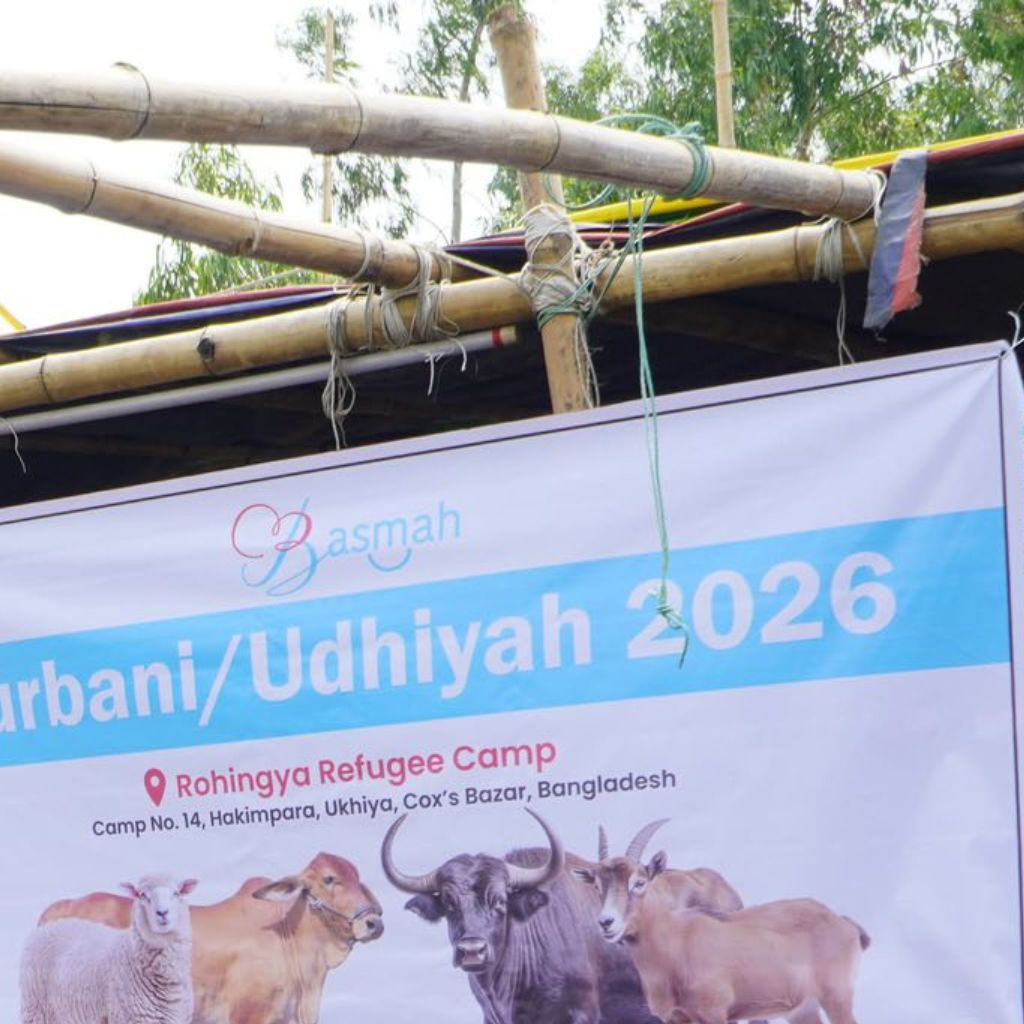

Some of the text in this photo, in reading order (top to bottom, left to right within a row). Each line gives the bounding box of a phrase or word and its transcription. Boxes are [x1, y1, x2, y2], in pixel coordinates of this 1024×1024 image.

[231, 497, 461, 596] Basmah
[627, 552, 896, 659] 2026
[92, 818, 146, 838] Camp
[151, 815, 179, 831] No.
[183, 812, 205, 830] 14,
[210, 805, 320, 827] Hakimpara,
[326, 795, 398, 819] Ukhiya,
[465, 785, 532, 805] Bazar,
[538, 769, 676, 800] Bangladesh
[176, 742, 556, 798] Rohingya Refugee Camp
